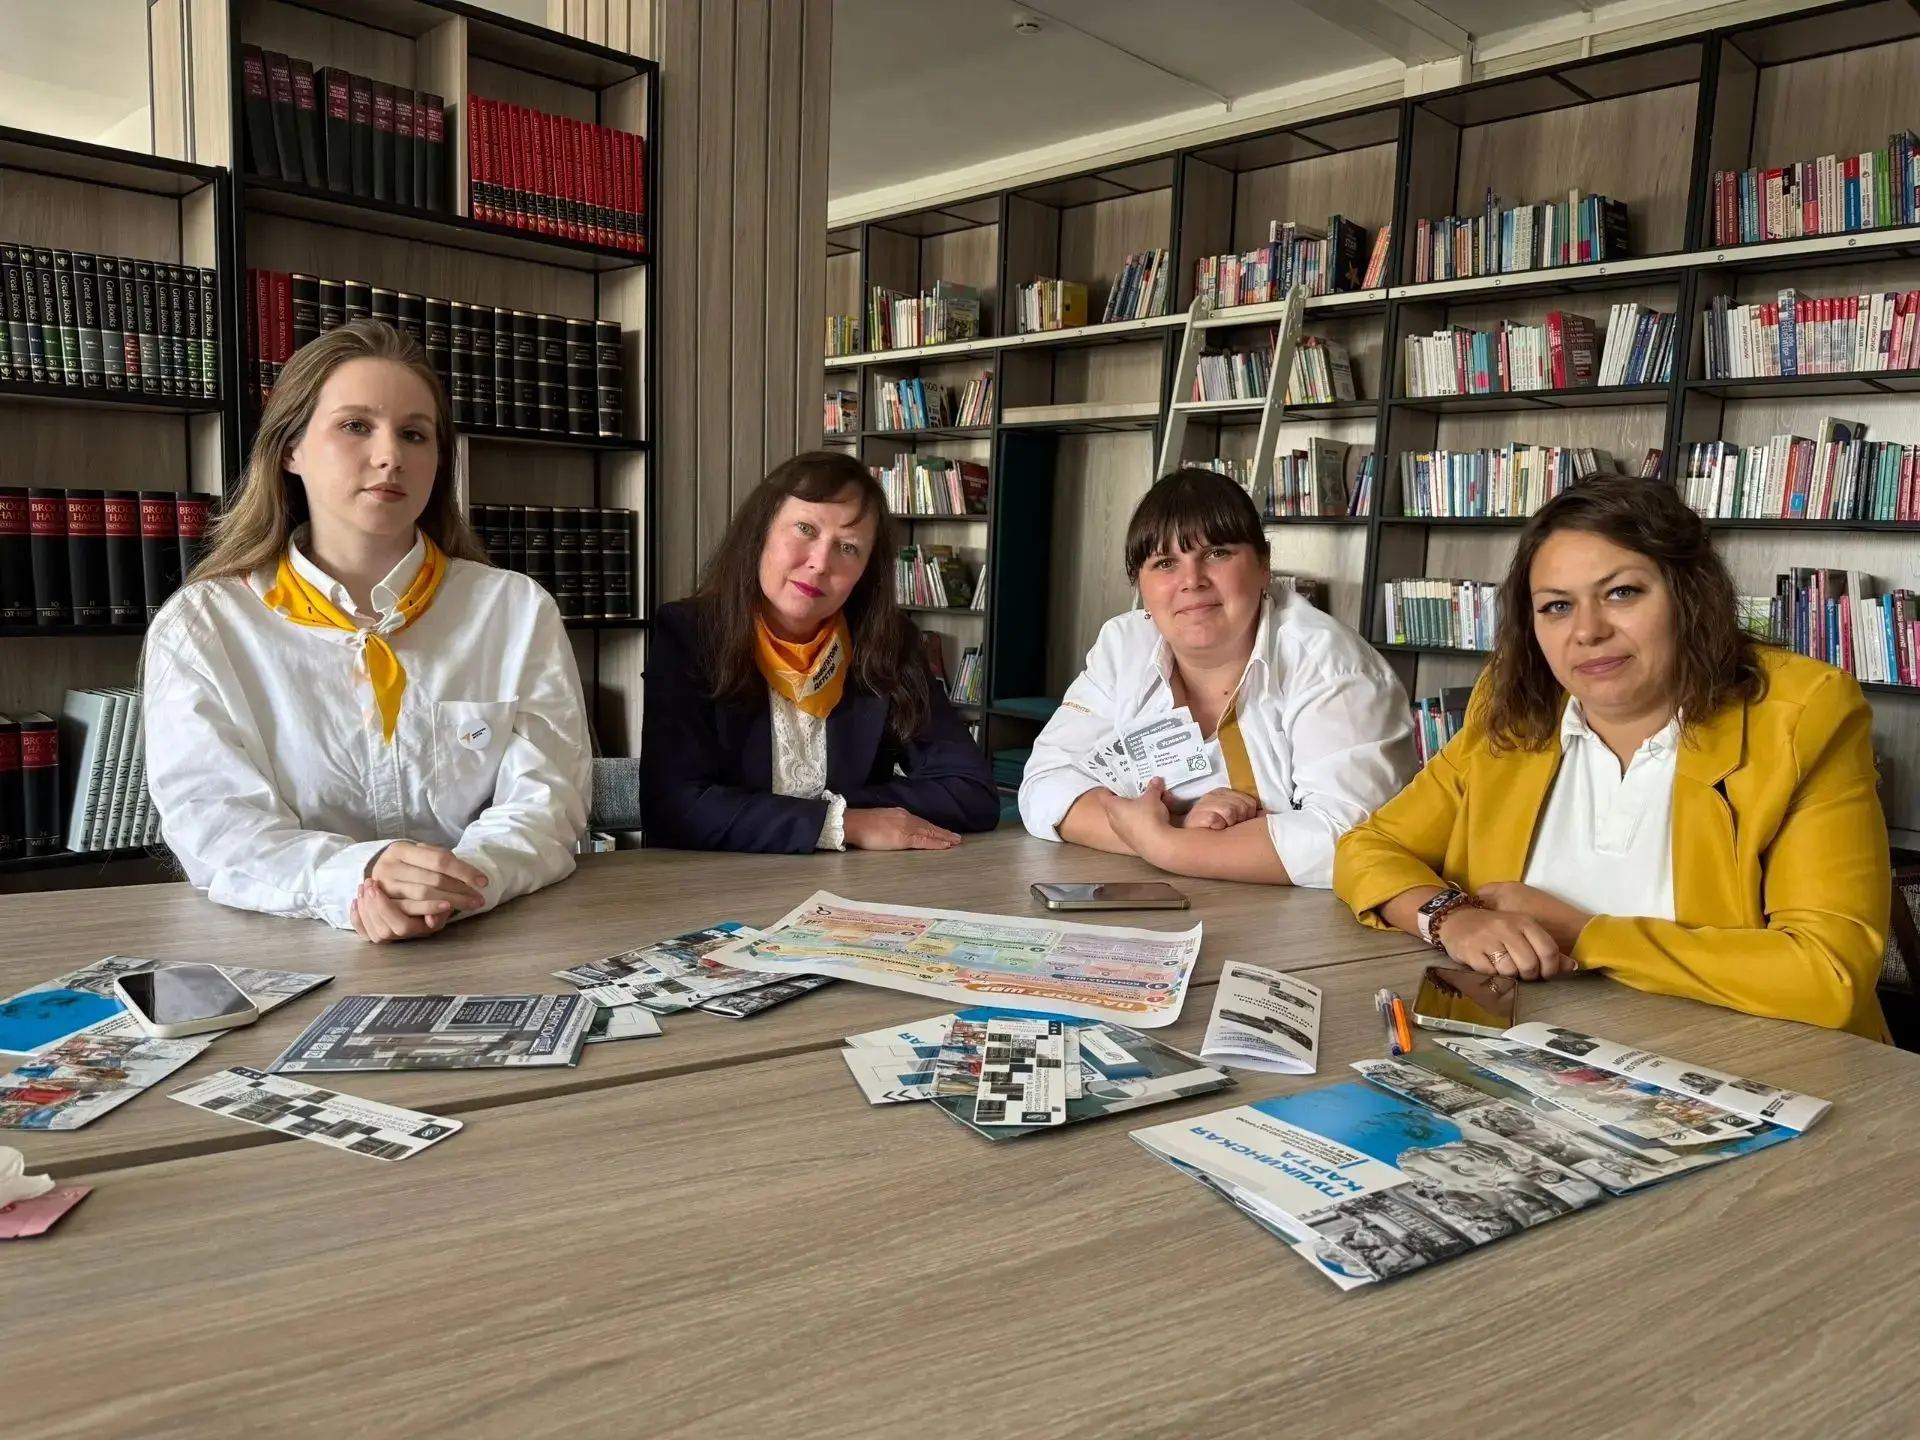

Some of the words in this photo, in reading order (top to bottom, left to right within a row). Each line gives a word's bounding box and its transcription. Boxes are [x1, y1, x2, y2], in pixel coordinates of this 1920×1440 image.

[9, 269, 18, 291] Great
[26, 272, 34, 294] Great
[42, 274, 51, 295] Great
[60, 276, 69, 297] Great
[83, 278, 92, 299] Great
[106, 280, 114, 302] Great
[124, 282, 132, 303] Great
[142, 284, 150, 306] Great
[160, 286, 168, 308] Great
[172, 288, 180, 308] Great
[188, 290, 196, 310] Great
[205, 292, 213, 312] Great
[12, 293, 20, 318] Books
[28, 296, 36, 320] Books
[44, 298, 54, 322] Books
[63, 299, 72, 323] Books
[85, 301, 94, 325] Books
[108, 304, 116, 327] Books
[126, 306, 135, 329] Books
[144, 308, 152, 330] Books
[160, 310, 168, 332] Books
[174, 311, 182, 334] Books
[206, 314, 214, 336] Books
[814, 663, 836, 691] ДЕТСТВА
[88, 760, 104, 799] VISUAL
[100, 758, 114, 797] VISUAL
[115, 758, 130, 798] VISUAL
[129, 758, 142, 796] VISUAL
[84, 801, 97, 822] ART
[96, 800, 108, 821] ART
[112, 799, 122, 820] ART
[124, 798, 136, 818] ART
[135, 799, 147, 819] ART
[976, 984, 1026, 994] ШВР
[1028, 990, 1134, 1010] ПАСПОРТ
[1189, 1126, 1344, 1198] ПУШКИНСКАЯ
[1281, 1150, 1365, 1192] КАРТА
